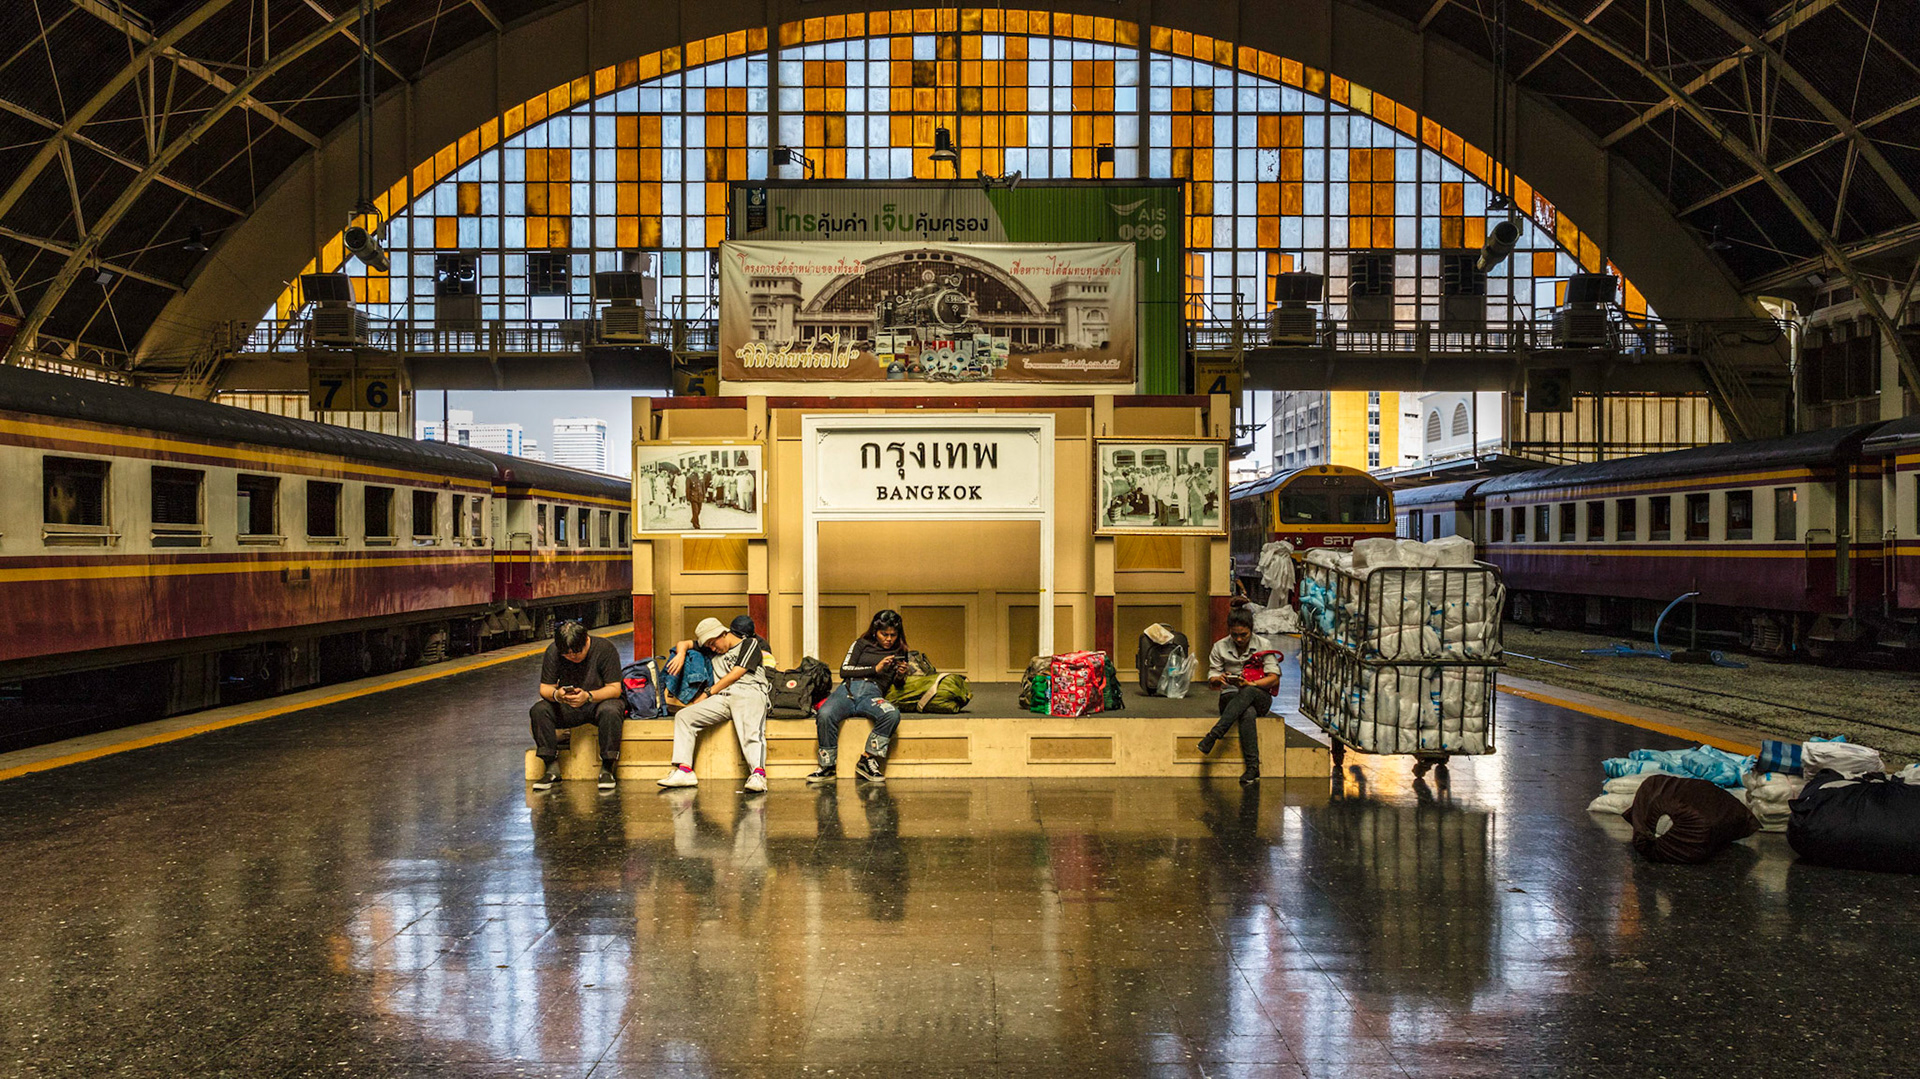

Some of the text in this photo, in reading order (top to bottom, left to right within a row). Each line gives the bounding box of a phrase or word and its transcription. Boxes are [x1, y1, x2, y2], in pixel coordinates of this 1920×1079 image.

[775, 205, 867, 238] โทรคุ้มค่า
[874, 203, 989, 238] เจ็บคุ้มครอง
[1138, 207, 1167, 221] AIS
[319, 380, 343, 409] 7
[366, 381, 389, 408] 6
[687, 377, 707, 396] 5
[1208, 375, 1233, 396] 4
[860, 442, 998, 480] กรุงเทพ
[876, 485, 983, 501] BANGKOK
[1323, 536, 1354, 546] SRT
